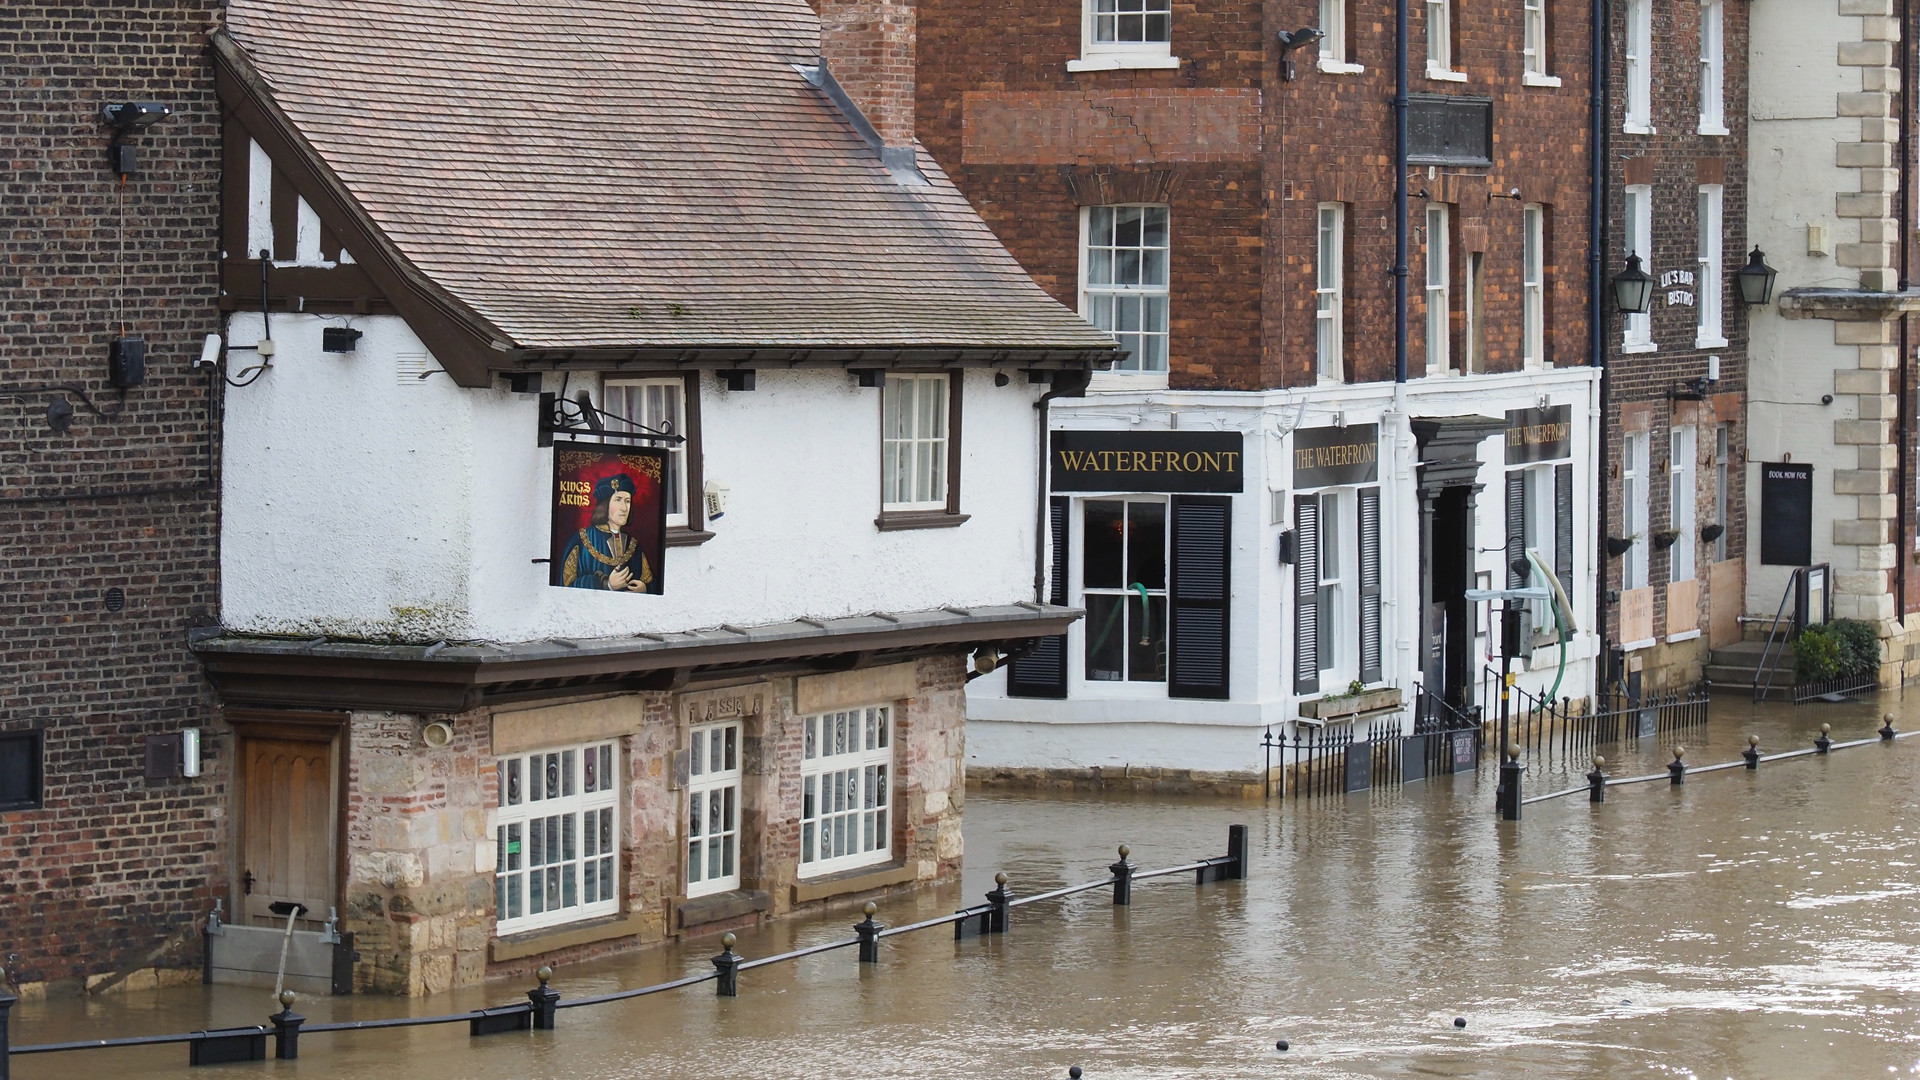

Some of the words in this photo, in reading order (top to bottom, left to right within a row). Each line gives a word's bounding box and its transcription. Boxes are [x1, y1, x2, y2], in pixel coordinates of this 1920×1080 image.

[1679, 270, 1694, 286] BAR
[1668, 290, 1694, 306] BISTRO
[1506, 427, 1522, 447] THE
[1523, 422, 1571, 445] WATERFRONT
[1059, 450, 1239, 473] WATERFRONT
[1295, 448, 1314, 470] THE
[1315, 442, 1378, 467] WATERFRONT
[1768, 470, 1784, 479] BOOK
[1784, 471, 1796, 479] NOW
[1796, 471, 1807, 480] FOR
[560, 480, 591, 494] KINGS
[559, 492, 590, 507] ARMS
